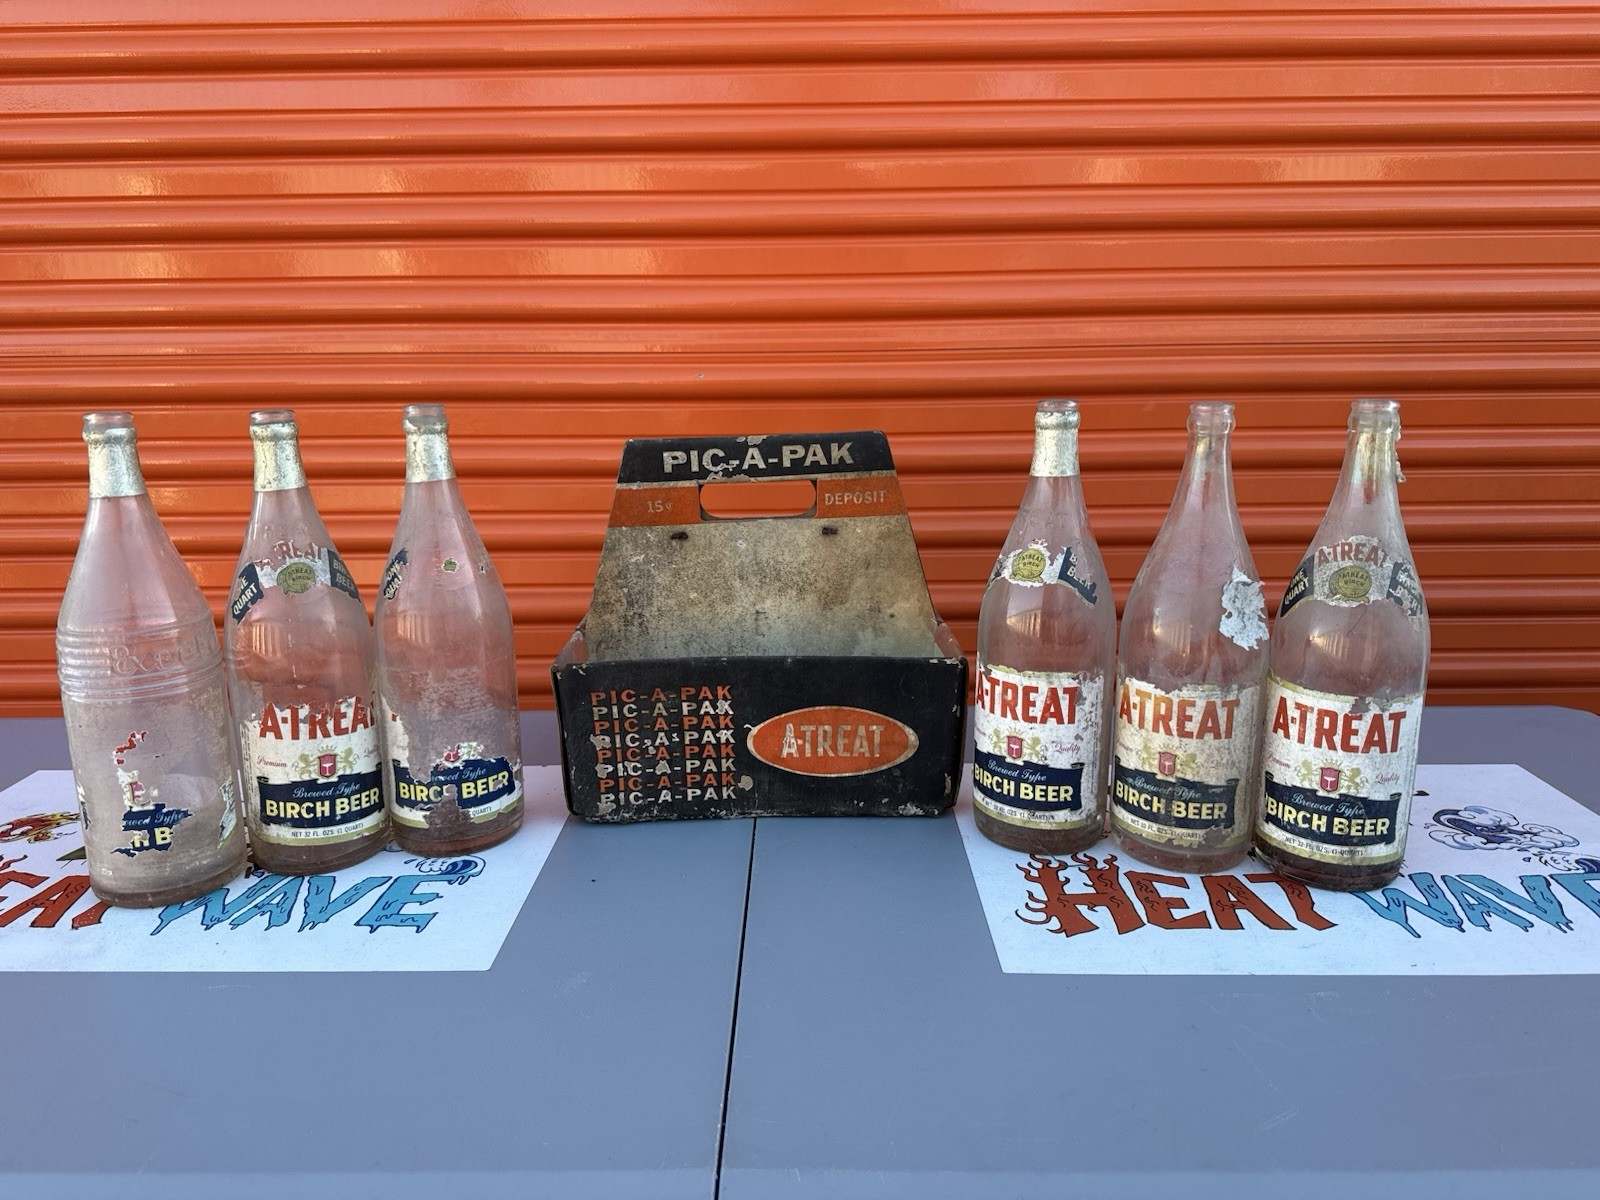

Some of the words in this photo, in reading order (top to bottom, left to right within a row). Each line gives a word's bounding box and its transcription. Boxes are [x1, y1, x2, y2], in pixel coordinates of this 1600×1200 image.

[662, 441, 855, 474] PIC-A-PAK
[824, 490, 887, 506] DEPOSIT
[232, 583, 258, 615] QUART
[590, 684, 733, 705] PIC-A-PAK
[976, 671, 1080, 725] A-TREAT
[592, 699, 735, 721] PIC-A-PAK
[1119, 683, 1241, 740] A-TREAT
[594, 715, 735, 735] PIC-A-PAK
[1272, 695, 1407, 754] A-TREAT
[596, 744, 736, 763] PIC-A-PAK
[1053, 740, 1081, 754] Quality
[257, 755, 287, 768] Premium
[988, 759, 1018, 778] Brewed
[1021, 768, 1047, 783] Type
[462, 767, 487, 780] Type
[600, 773, 736, 793] PIC-A-PAK
[973, 763, 1015, 797] BIRCH
[1020, 782, 1074, 802] BEER
[1375, 771, 1400, 786] Quality
[293, 786, 334, 799] Brewed
[335, 782, 360, 796] Type
[399, 781, 449, 802] BIRC
[1116, 780, 1166, 815] BIRCH
[1172, 800, 1228, 820] BEER
[265, 799, 330, 819] BIRCH
[335, 787, 380, 815] BEER
[1291, 792, 1332, 812] Brewed
[1336, 801, 1365, 818] Type
[155, 810, 184, 824] Type
[1267, 797, 1327, 834] BIRCH
[1333, 817, 1390, 837] BEER
[150, 873, 460, 936] WAVE
[1016, 852, 1338, 938] HEAT
